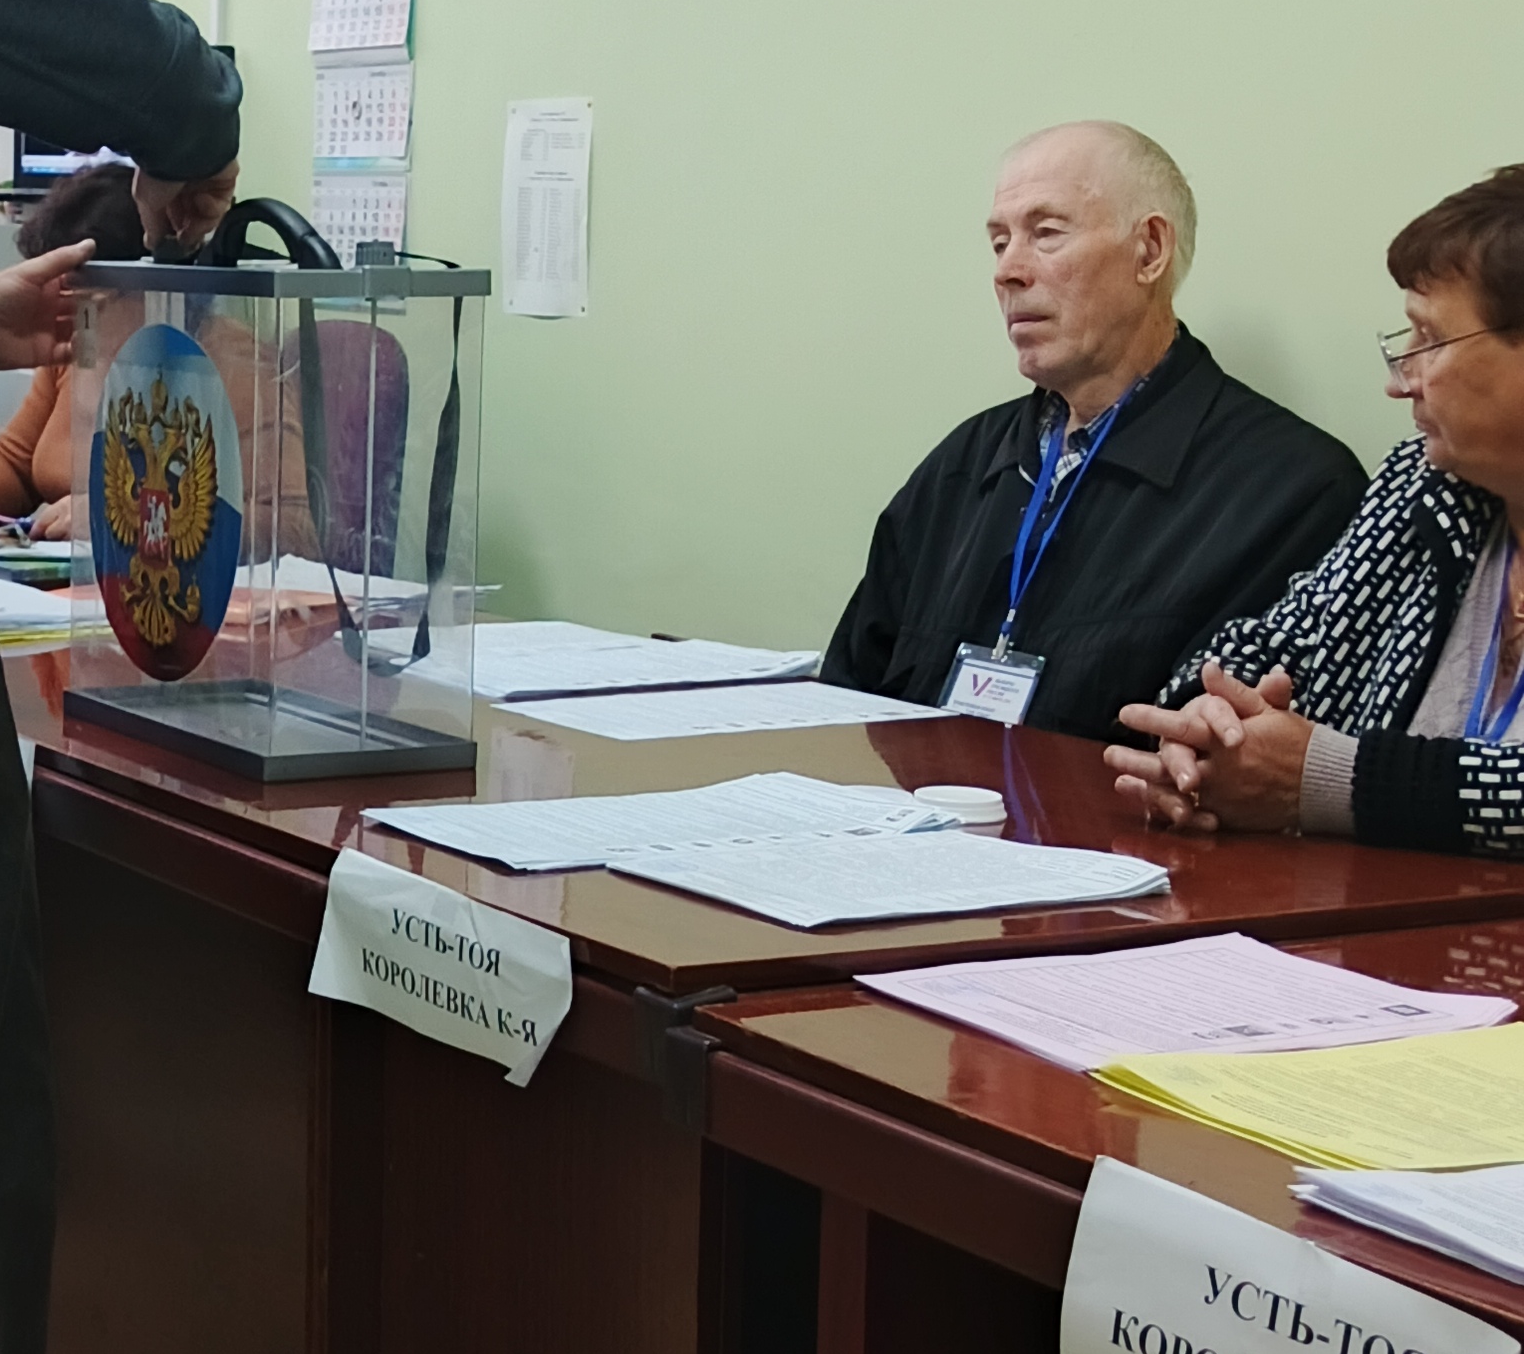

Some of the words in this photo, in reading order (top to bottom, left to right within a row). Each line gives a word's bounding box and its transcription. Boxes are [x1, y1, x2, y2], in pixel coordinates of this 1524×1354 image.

[391, 908, 500, 977] УСТЬ-ТОЯ
[362, 947, 490, 1030] КОРОЛЕВКА
[496, 1007, 538, 1046] К-Я
